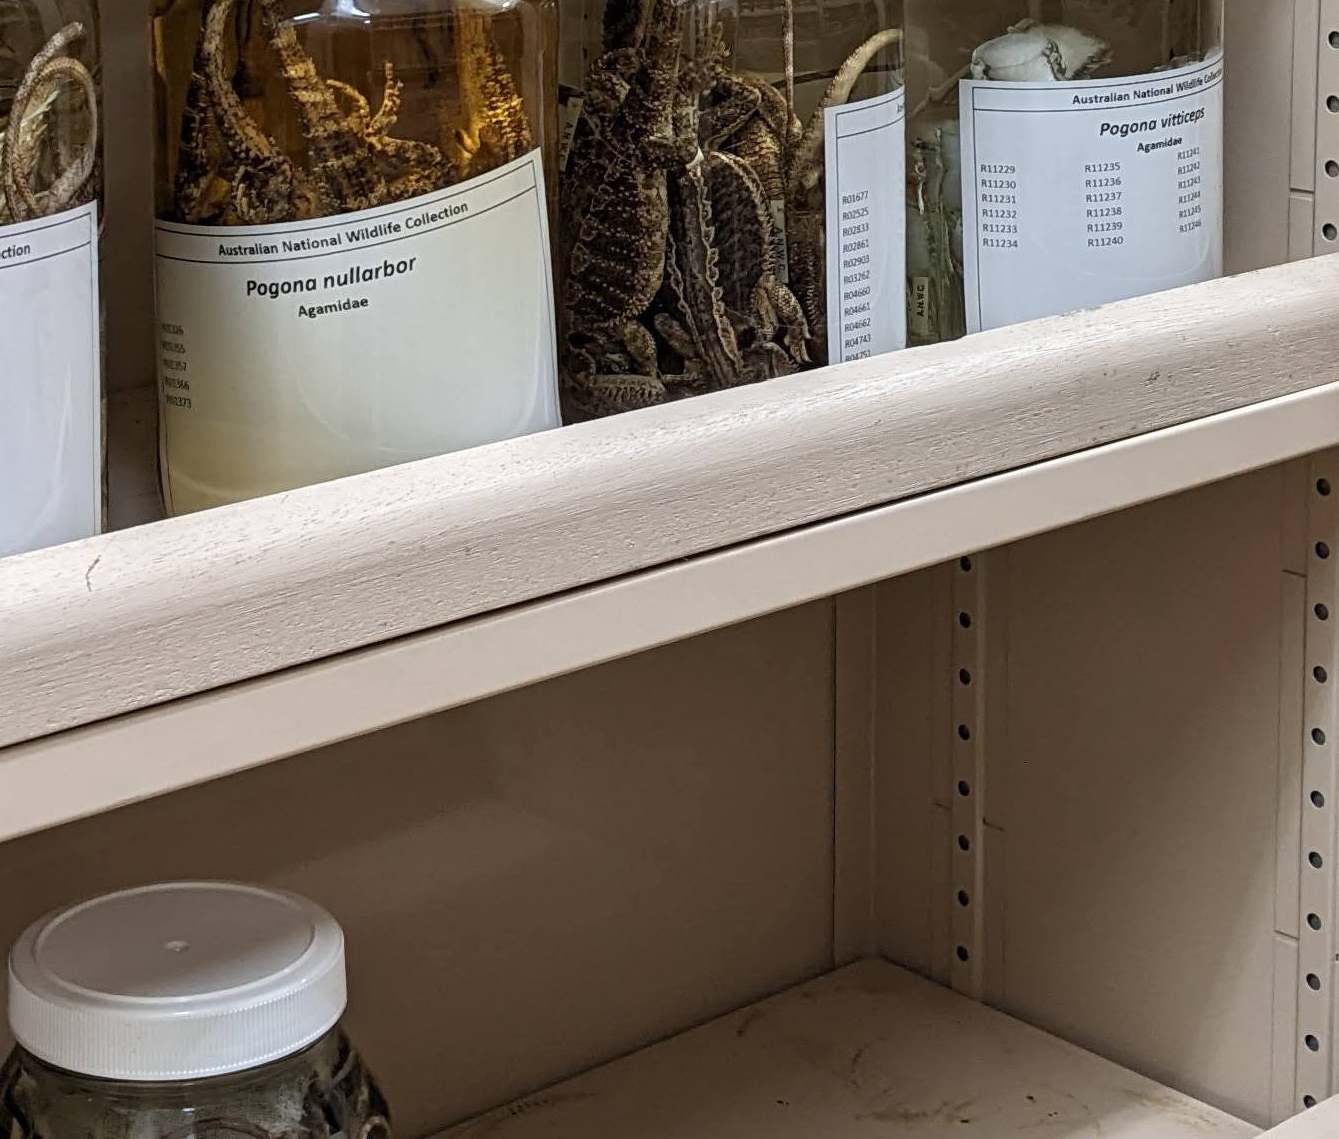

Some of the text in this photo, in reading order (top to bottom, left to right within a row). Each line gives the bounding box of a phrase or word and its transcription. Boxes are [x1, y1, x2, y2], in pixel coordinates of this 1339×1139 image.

[1072, 78, 1202, 104] Australian National Wildlife
[1100, 107, 1205, 137] Pogona vitticeps
[1137, 137, 1182, 152] Agamidae
[980, 165, 1015, 174] R11229
[1085, 162, 1120, 172] R11235
[981, 179, 1016, 189] R11230
[1085, 177, 1121, 187] R11236
[982, 194, 1016, 204] R11231
[1086, 192, 1121, 203] R11237
[982, 209, 1016, 218] R11232
[1087, 207, 1122, 218] R11238
[218, 202, 468, 256] Australian National Wildlife Collection
[983, 224, 1017, 233] R11233
[1087, 222, 1122, 232] R11239
[983, 238, 1018, 248] R11234
[1088, 236, 1123, 247] R11240
[247, 258, 416, 299] Pogona nullarbor
[298, 298, 368, 319] Agamidae
